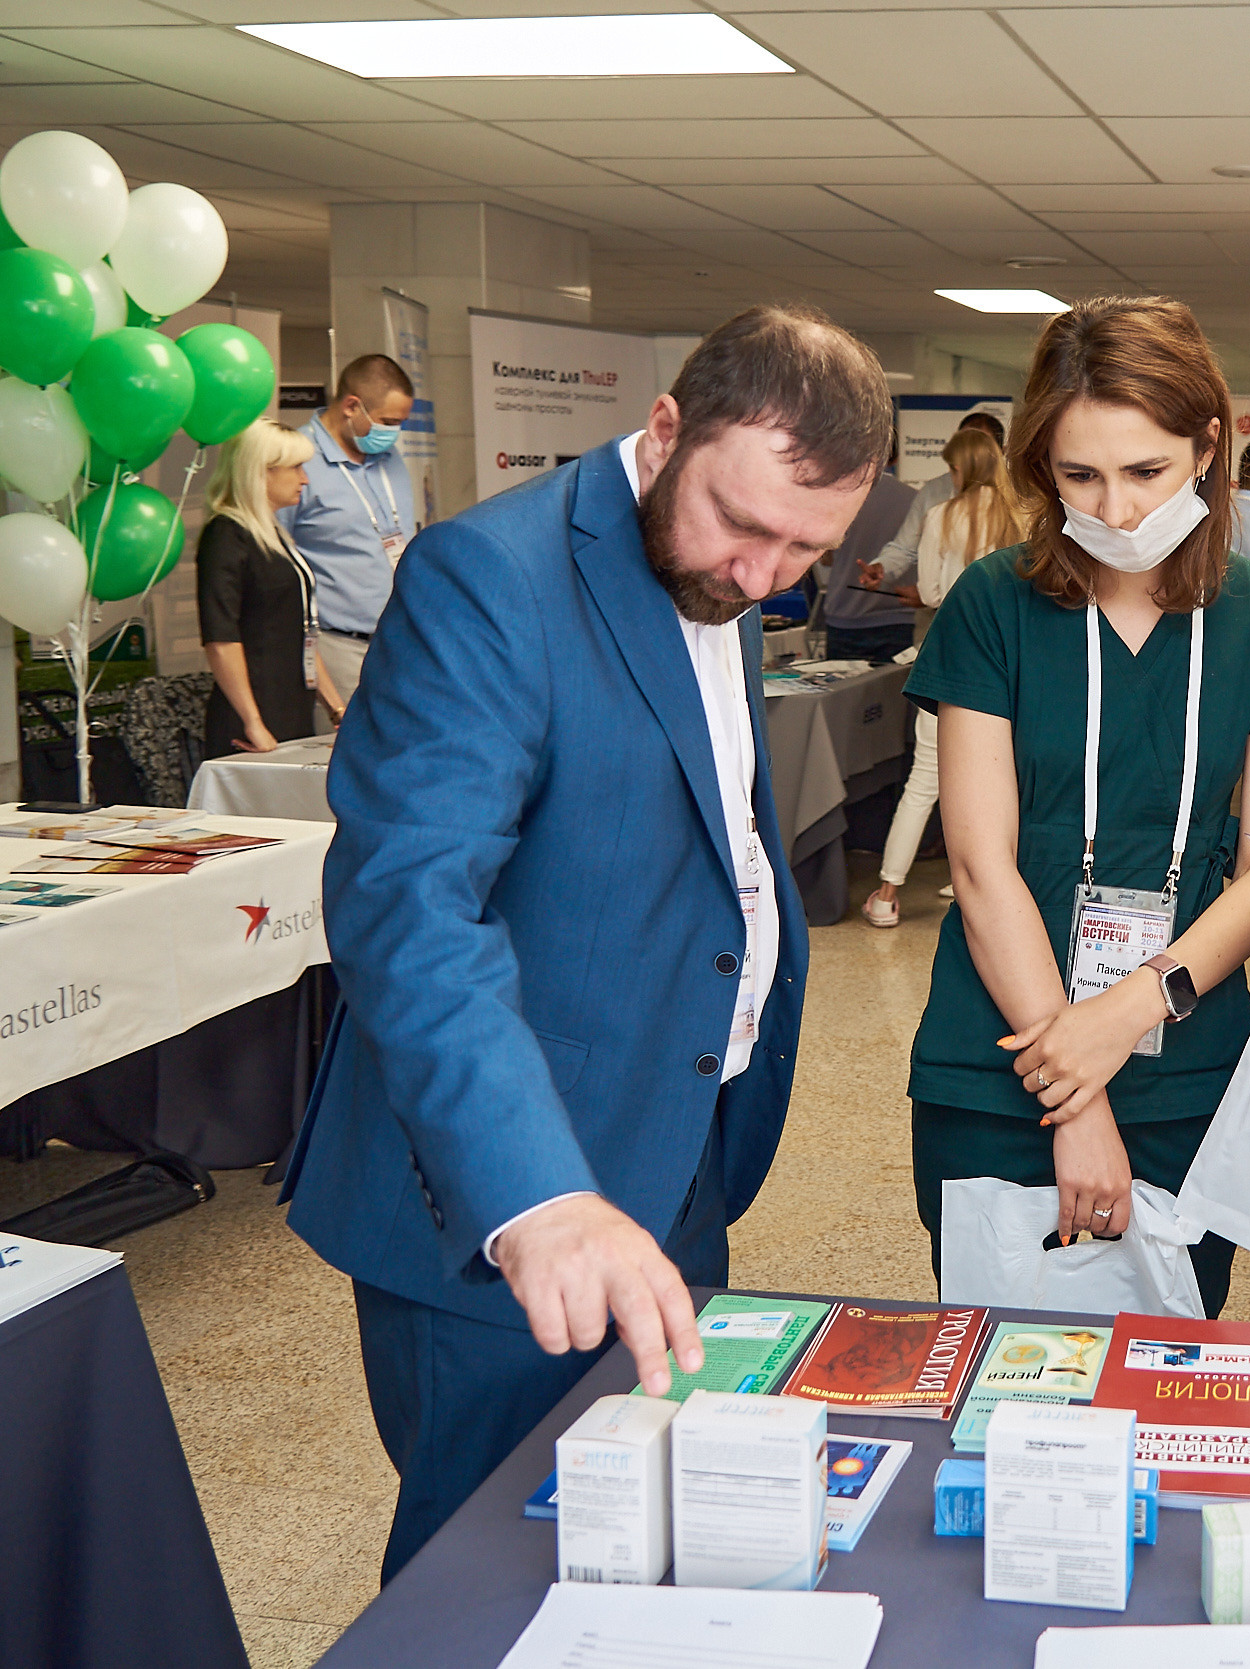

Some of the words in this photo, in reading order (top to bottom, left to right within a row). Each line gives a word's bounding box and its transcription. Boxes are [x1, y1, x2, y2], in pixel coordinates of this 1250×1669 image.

[493, 361, 555, 383] Комплекс
[559, 371, 580, 384] для
[496, 452, 546, 469] Quasar
[1082, 927, 1130, 943] ВСТРЕЧИ
[1141, 932, 1164, 940] ИЮНЯ
[1141, 938, 1163, 948] 2021
[1077, 977, 1101, 987] Ирина
[0, 984, 101, 1039] astellas
[915, 1310, 975, 1391] УРОЛОГИЯ
[800, 1385, 854, 1401] КЛИНИЧЕСКАЯ
[857, 1393, 863, 1401] И
[864, 1391, 950, 1402] ЭКСПЕРИМЕНТАЛЬНАЯ
